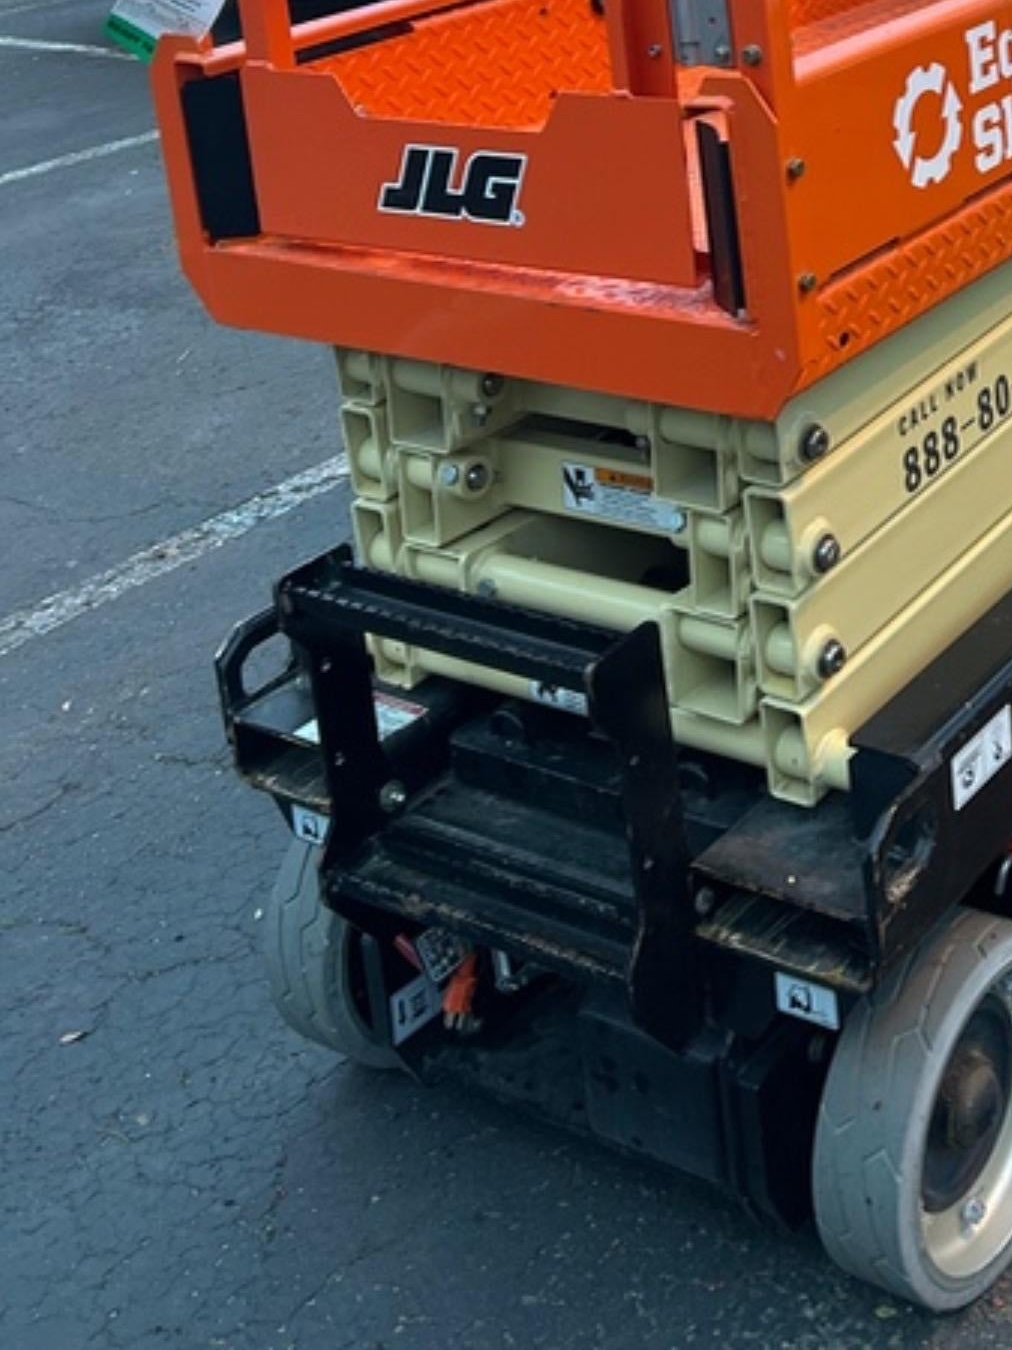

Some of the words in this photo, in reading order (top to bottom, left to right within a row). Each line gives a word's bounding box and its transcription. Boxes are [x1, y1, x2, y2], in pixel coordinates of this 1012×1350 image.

[377, 143, 528, 226] JLG
[898, 395, 939, 437] CALL
[945, 360, 980, 398] NOW
